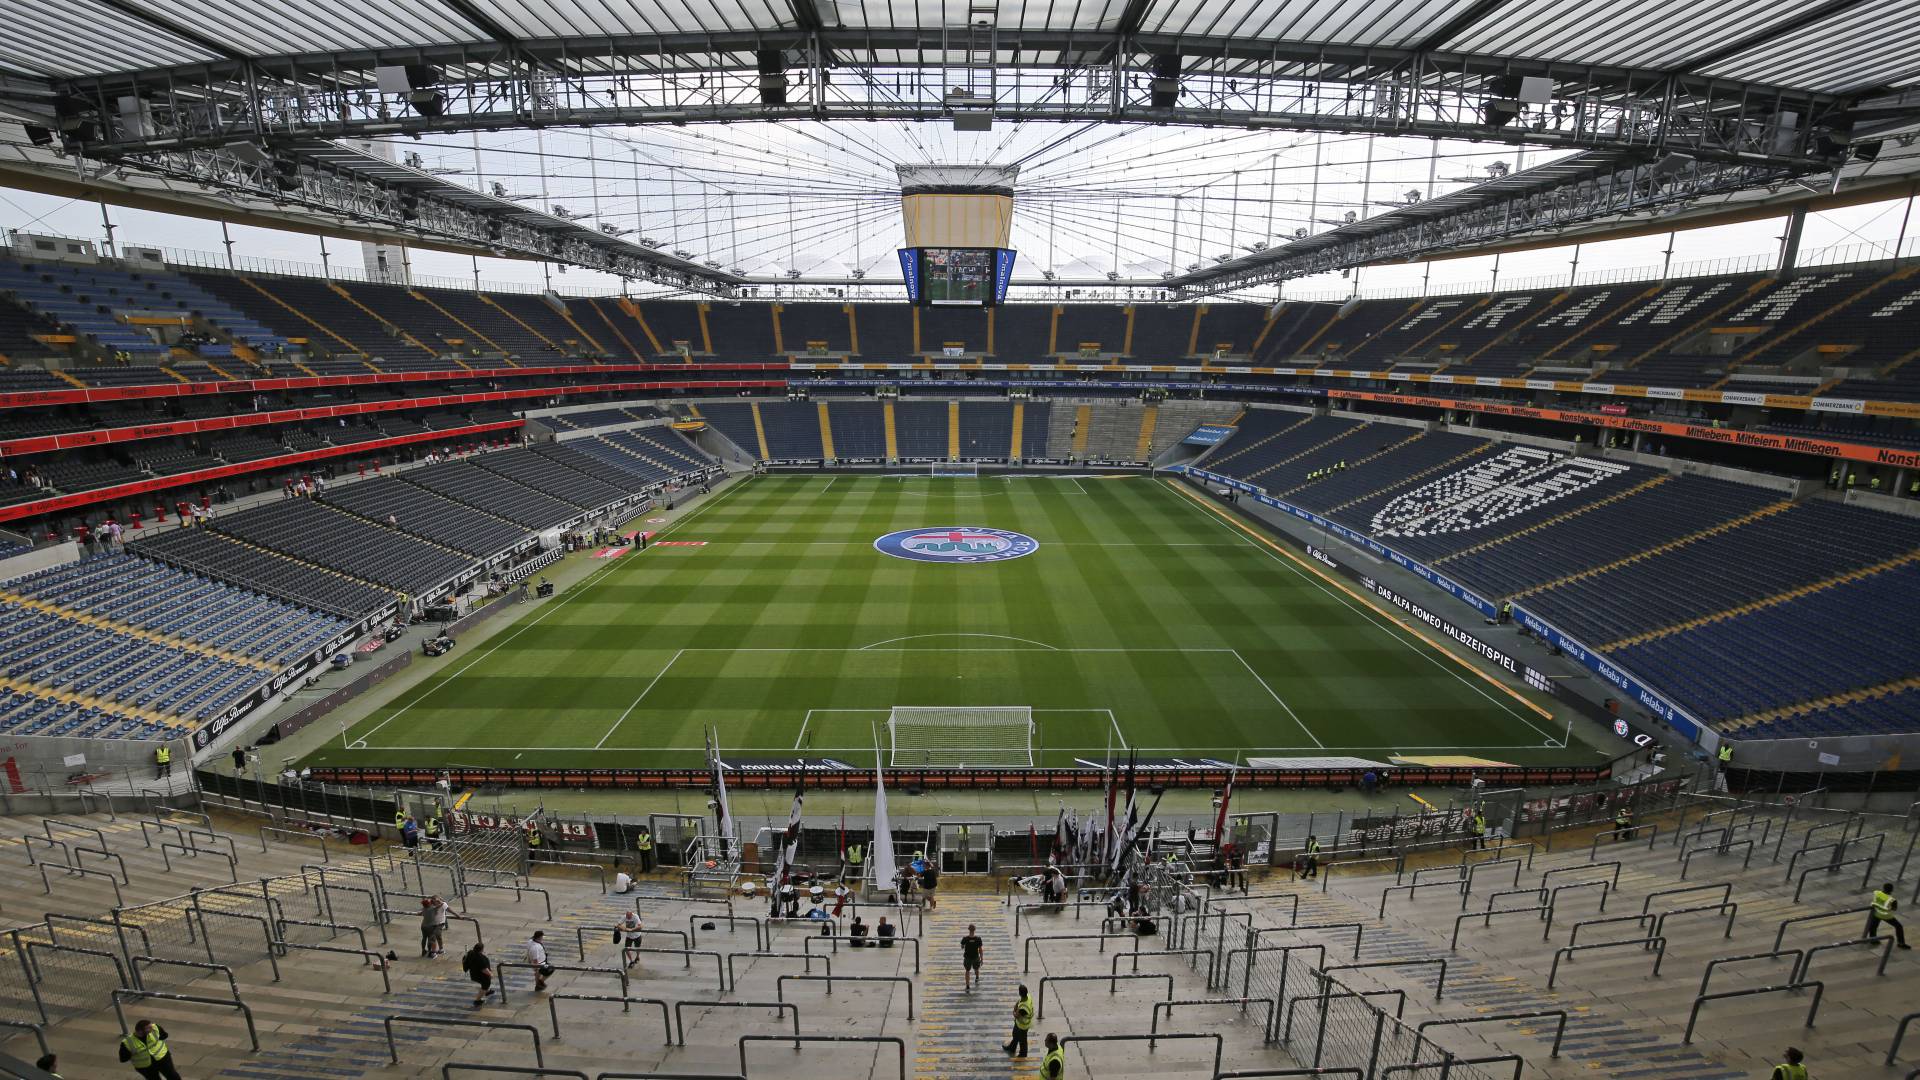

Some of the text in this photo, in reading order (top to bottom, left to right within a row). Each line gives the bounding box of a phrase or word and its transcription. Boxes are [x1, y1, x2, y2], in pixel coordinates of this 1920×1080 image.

[1723, 395, 1757, 403] COMMERZBANK
[1813, 401, 1853, 410] COMMERZBANK
[1559, 412, 1662, 433] Nonstop you Lufthansa
[1686, 427, 1842, 457] Mitfiebern. Mitfeiern. Mitfliegen.
[1413, 564, 1426, 577] Helaba
[1436, 576, 1451, 590] Helaba
[1462, 591, 1477, 606] Helaba
[371, 606, 397, 627] Alfa Romeo
[1525, 615, 1542, 633] Helaba
[1378, 585, 1517, 673] DAS ALFA ROMEO HALBZEITSPIEL
[325, 631, 356, 656] Alfa Romeo
[1559, 637, 1578, 656] Helaba
[273, 662, 309, 691] Alfa Romeo
[1598, 662, 1620, 684] Helaba
[1640, 690, 1664, 716] Helaba
[212, 700, 254, 735] Alfa Romeo
